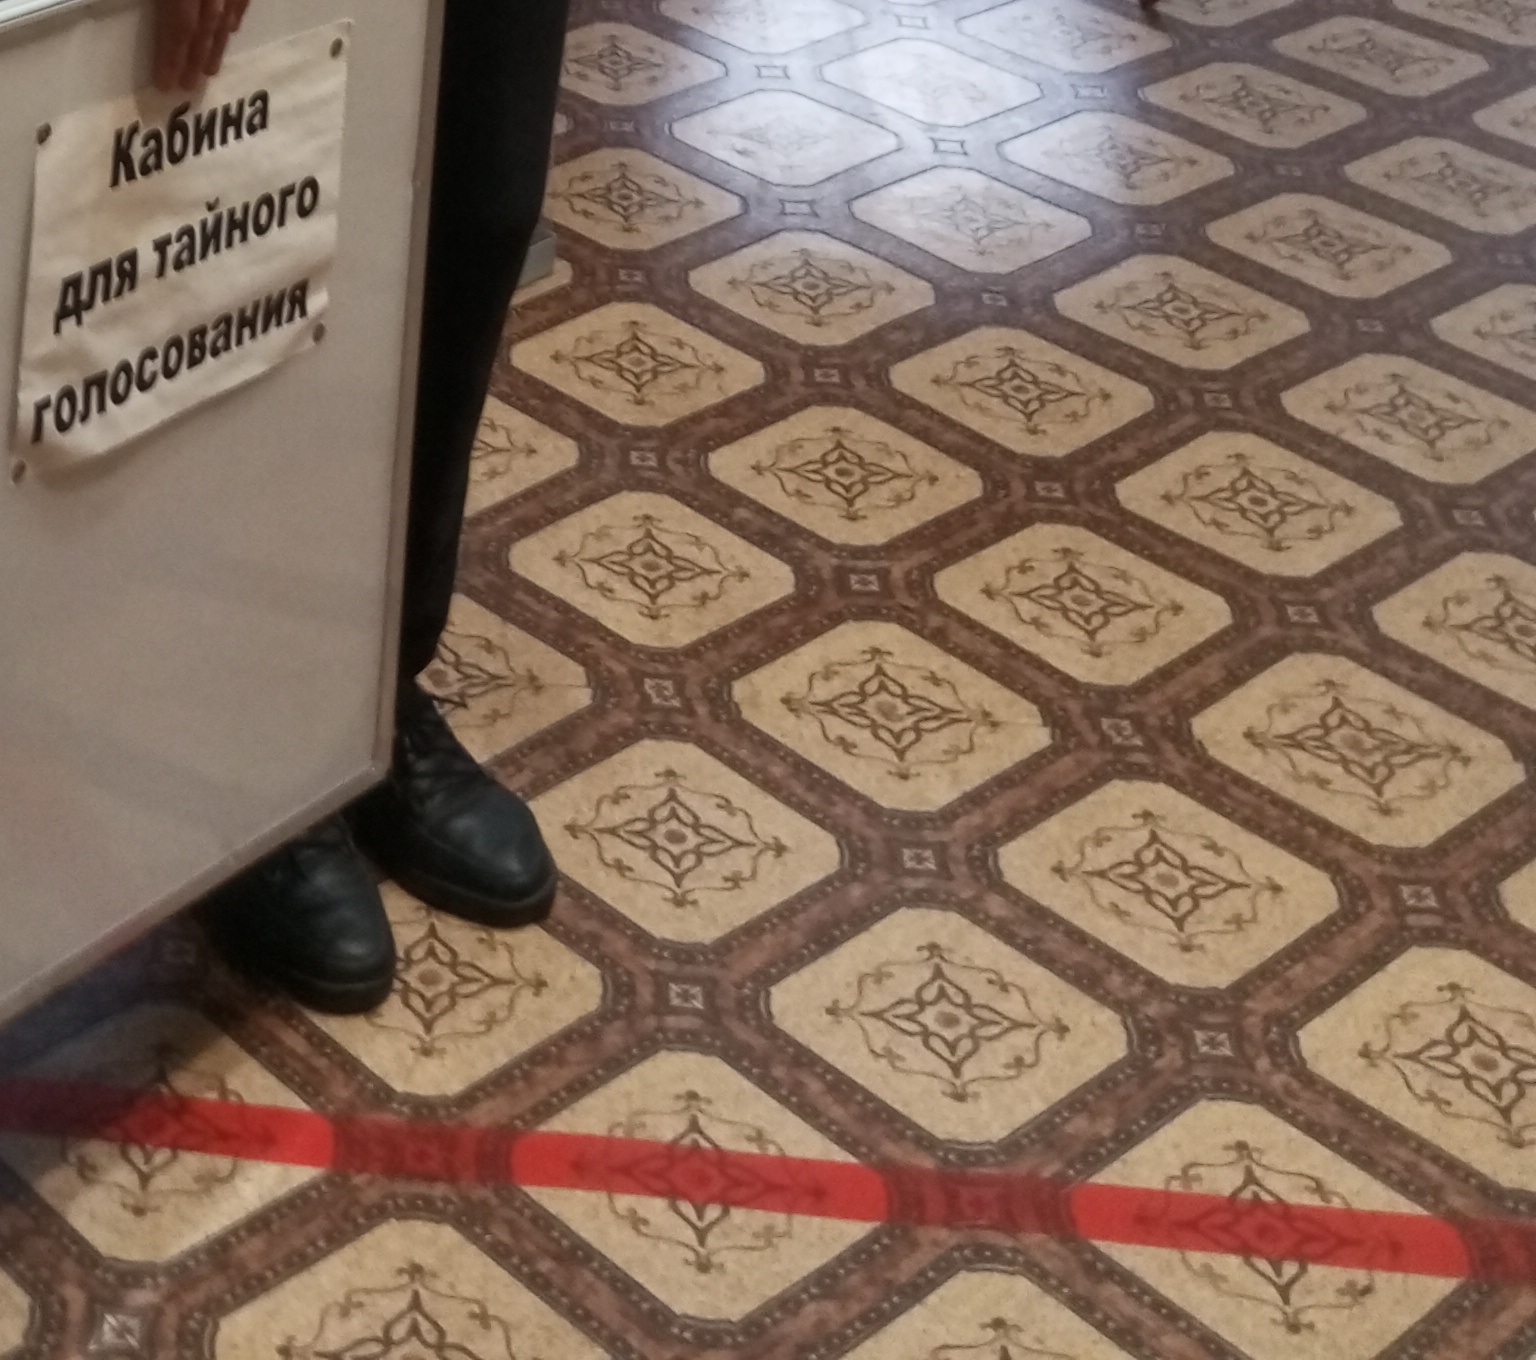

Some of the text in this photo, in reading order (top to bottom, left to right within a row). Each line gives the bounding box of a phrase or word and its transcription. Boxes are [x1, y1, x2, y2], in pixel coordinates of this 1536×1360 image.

[109, 89, 270, 188] Кабина
[54, 175, 321, 335] для тайного
[31, 278, 310, 444] голосования
